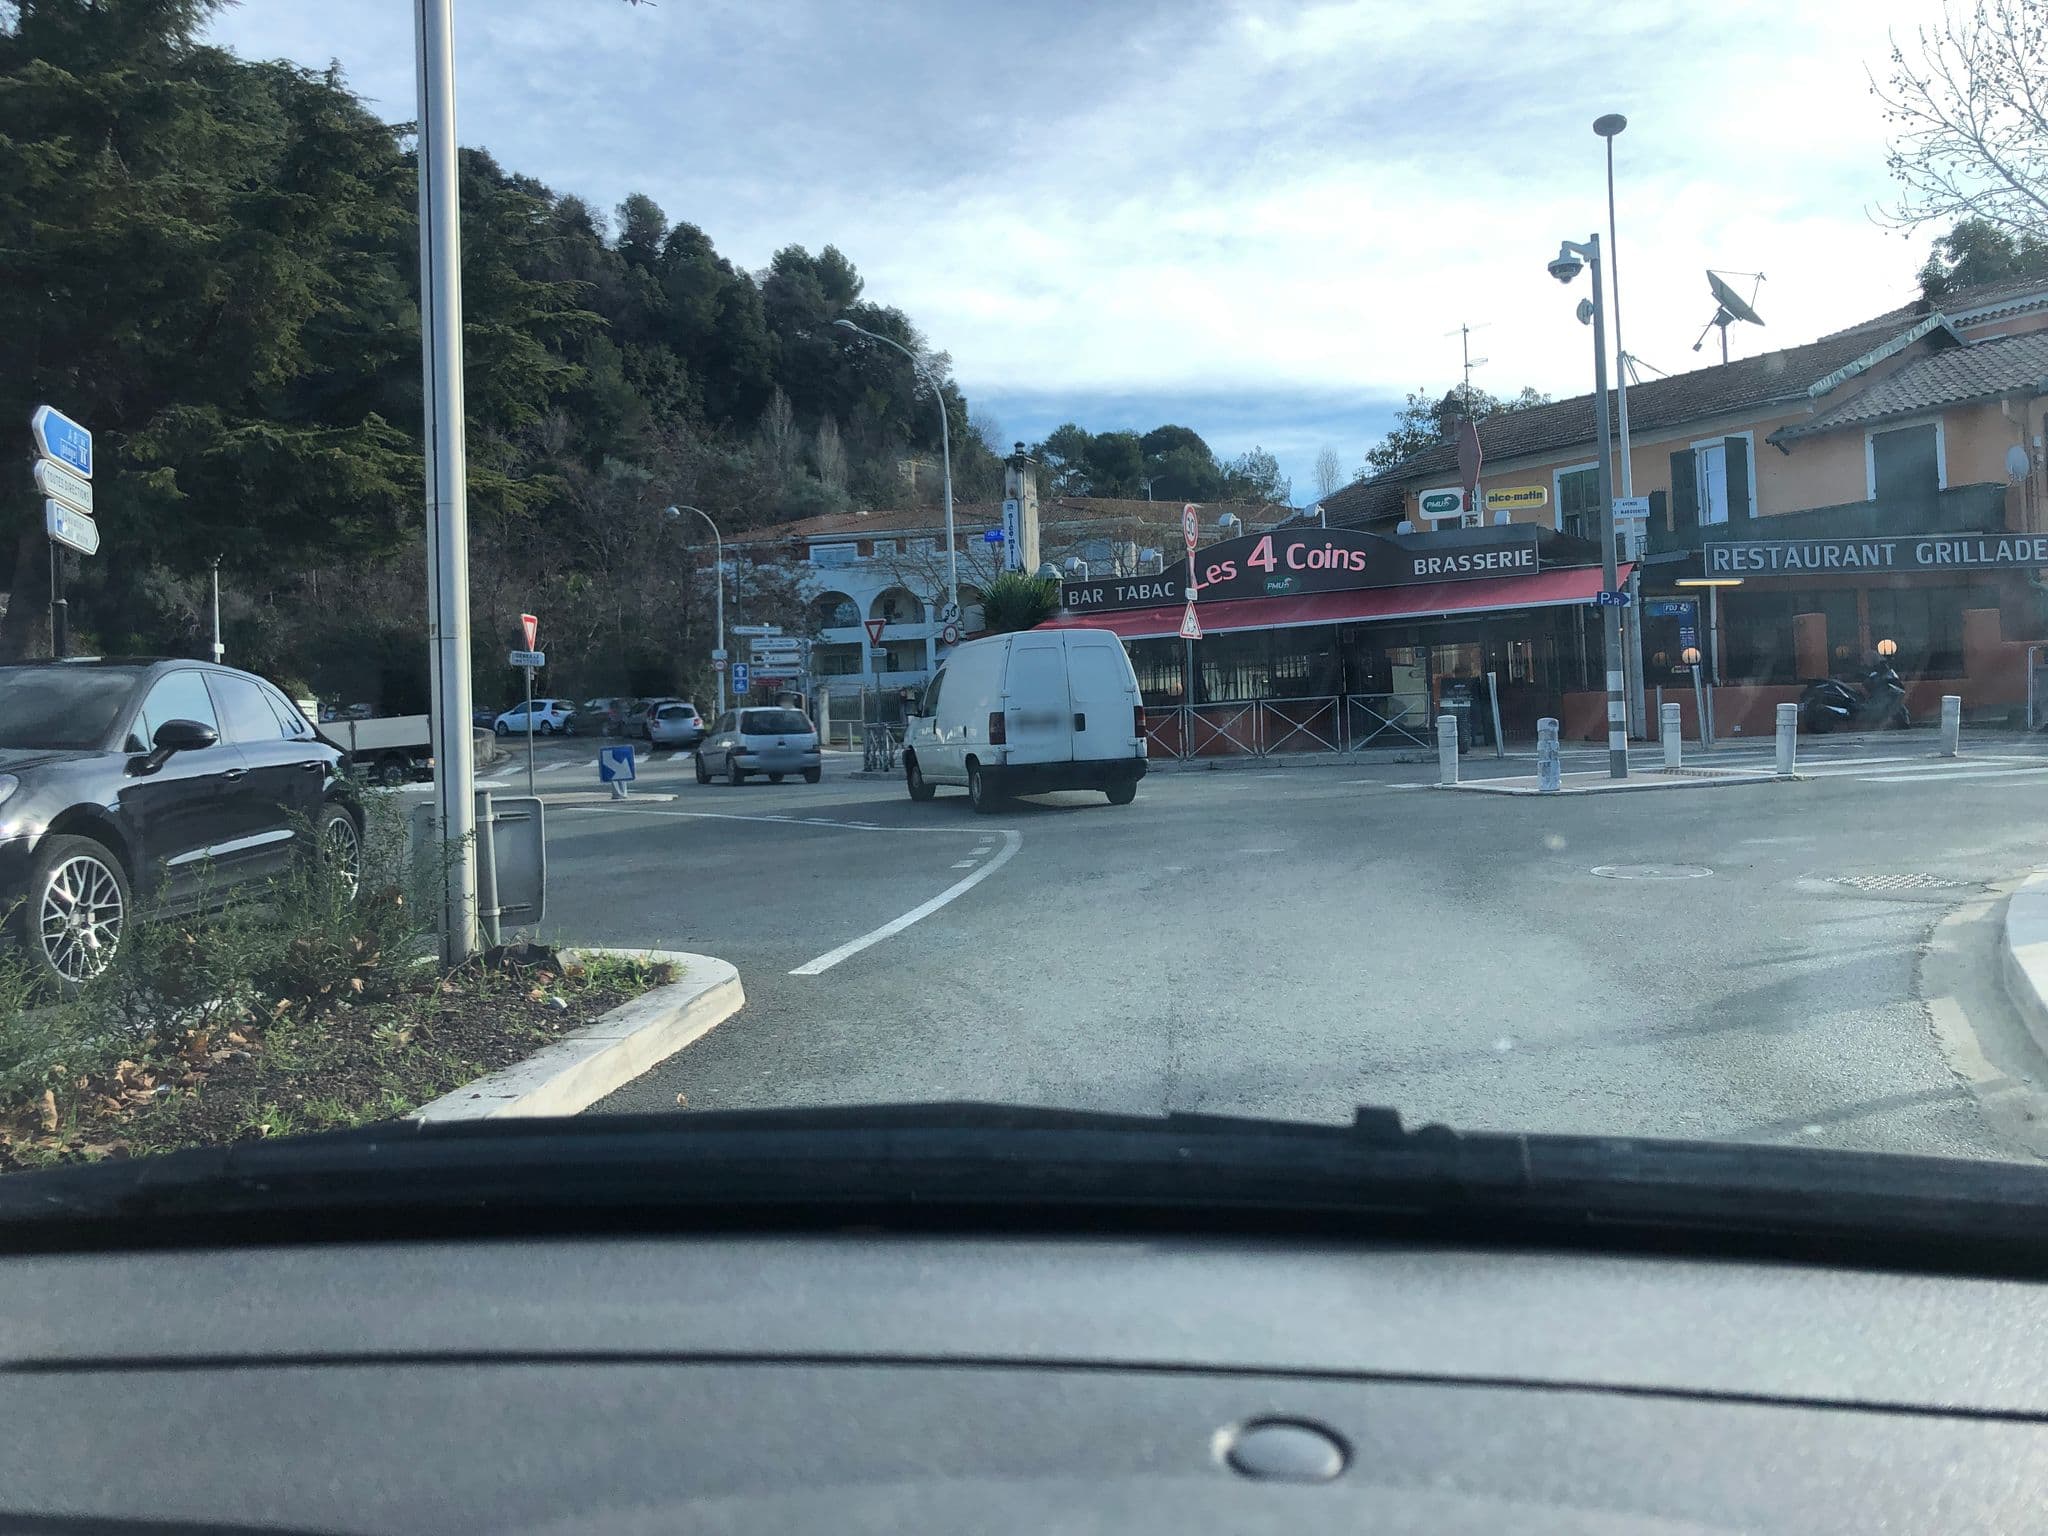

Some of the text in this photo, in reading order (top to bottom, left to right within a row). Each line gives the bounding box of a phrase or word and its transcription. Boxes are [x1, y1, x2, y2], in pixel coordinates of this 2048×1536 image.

[1488, 490, 1544, 504] nice-matin
[1189, 535, 1367, 590] Les 4 Coins
[1413, 549, 1534, 576] BRASSERIE
[1712, 538, 2048, 571] RESTAURANT GRILLADE
[1068, 581, 1175, 606] BAR TABAC
[944, 609, 957, 618] 30
